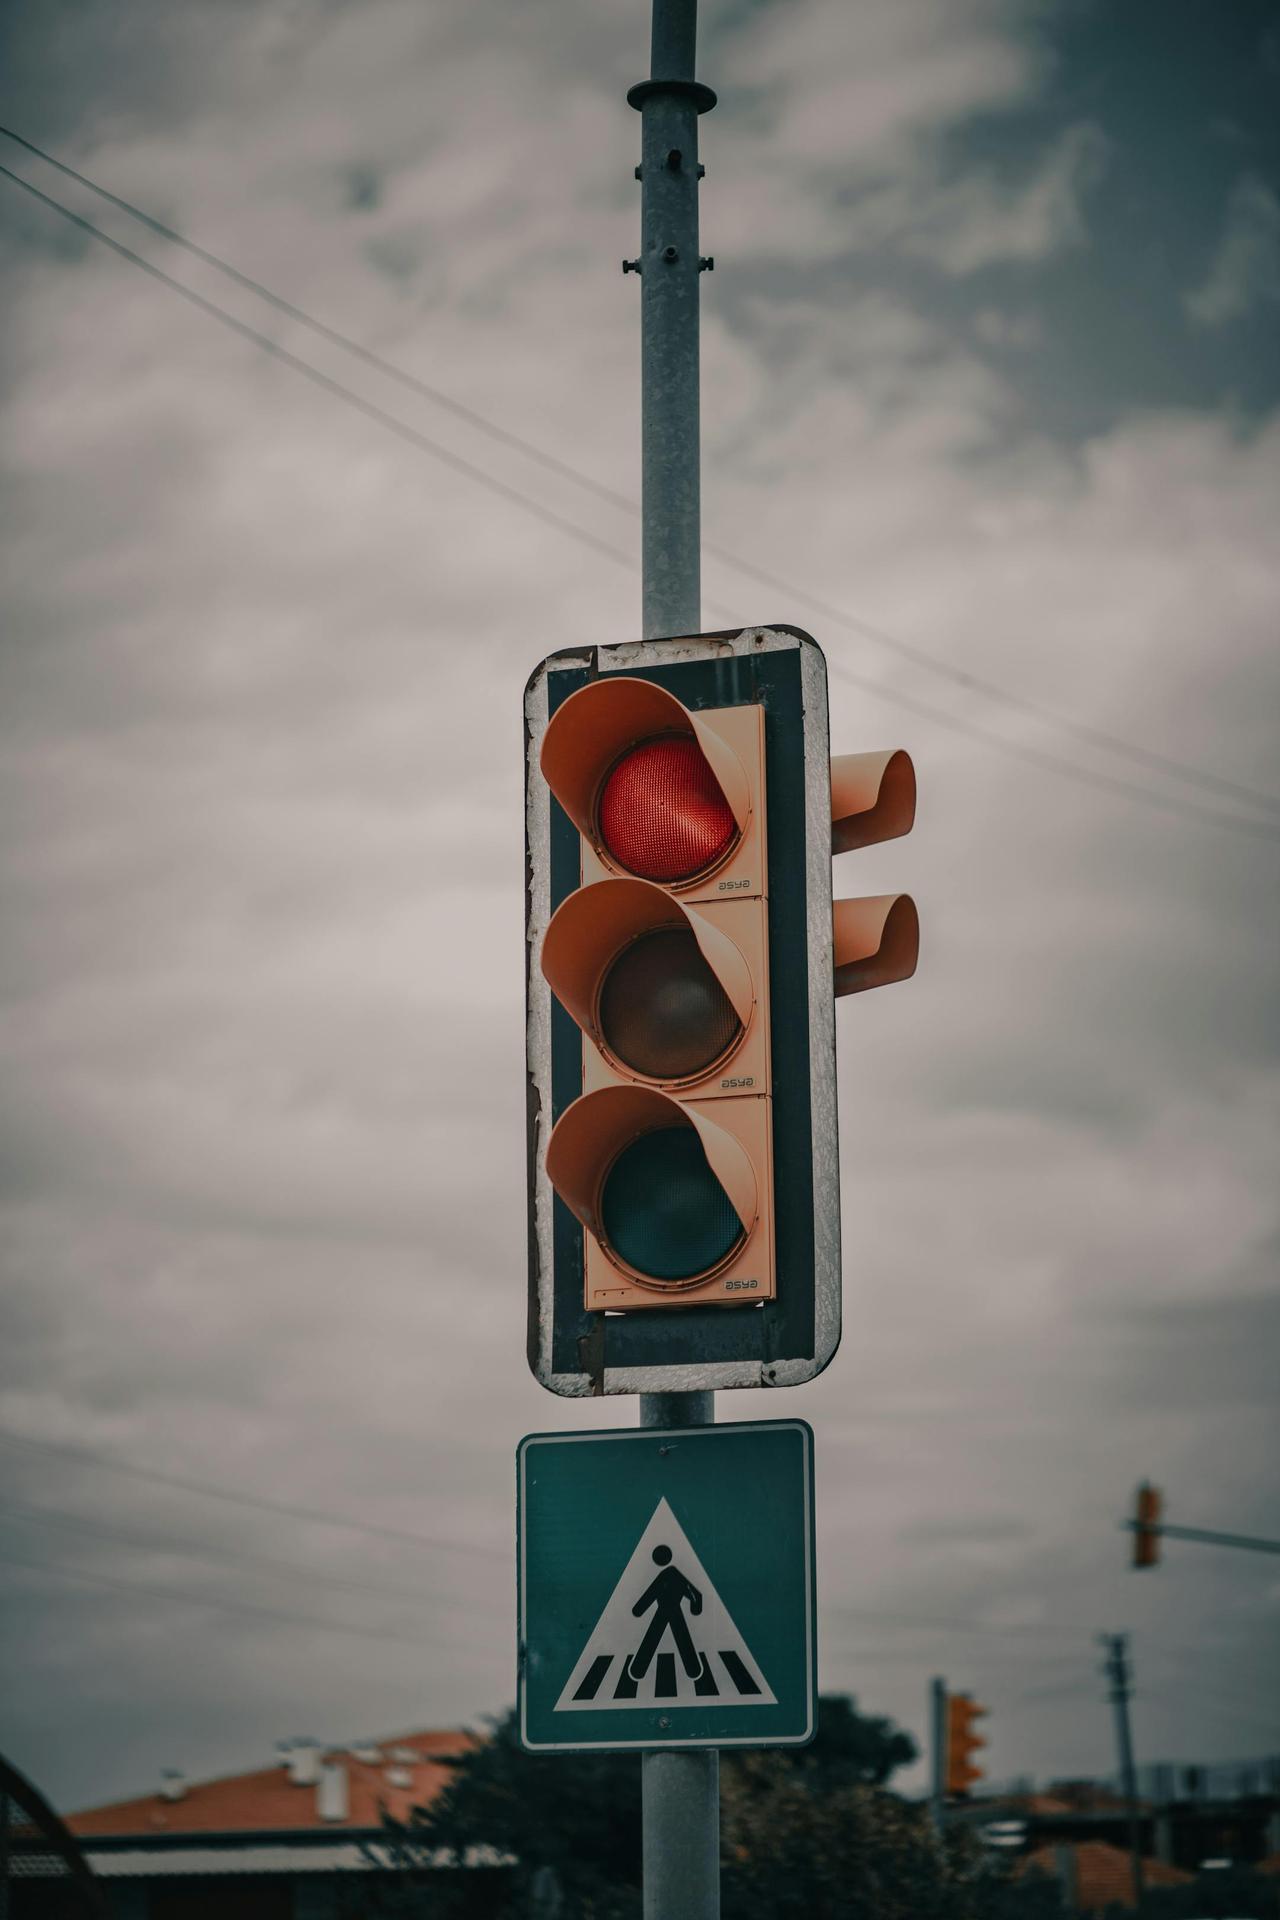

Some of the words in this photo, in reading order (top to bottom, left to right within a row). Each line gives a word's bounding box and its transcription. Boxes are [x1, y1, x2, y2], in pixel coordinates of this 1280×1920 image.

[719, 880, 750, 890] asya
[721, 1077, 754, 1088] asya
[726, 1280, 758, 1290] asya
